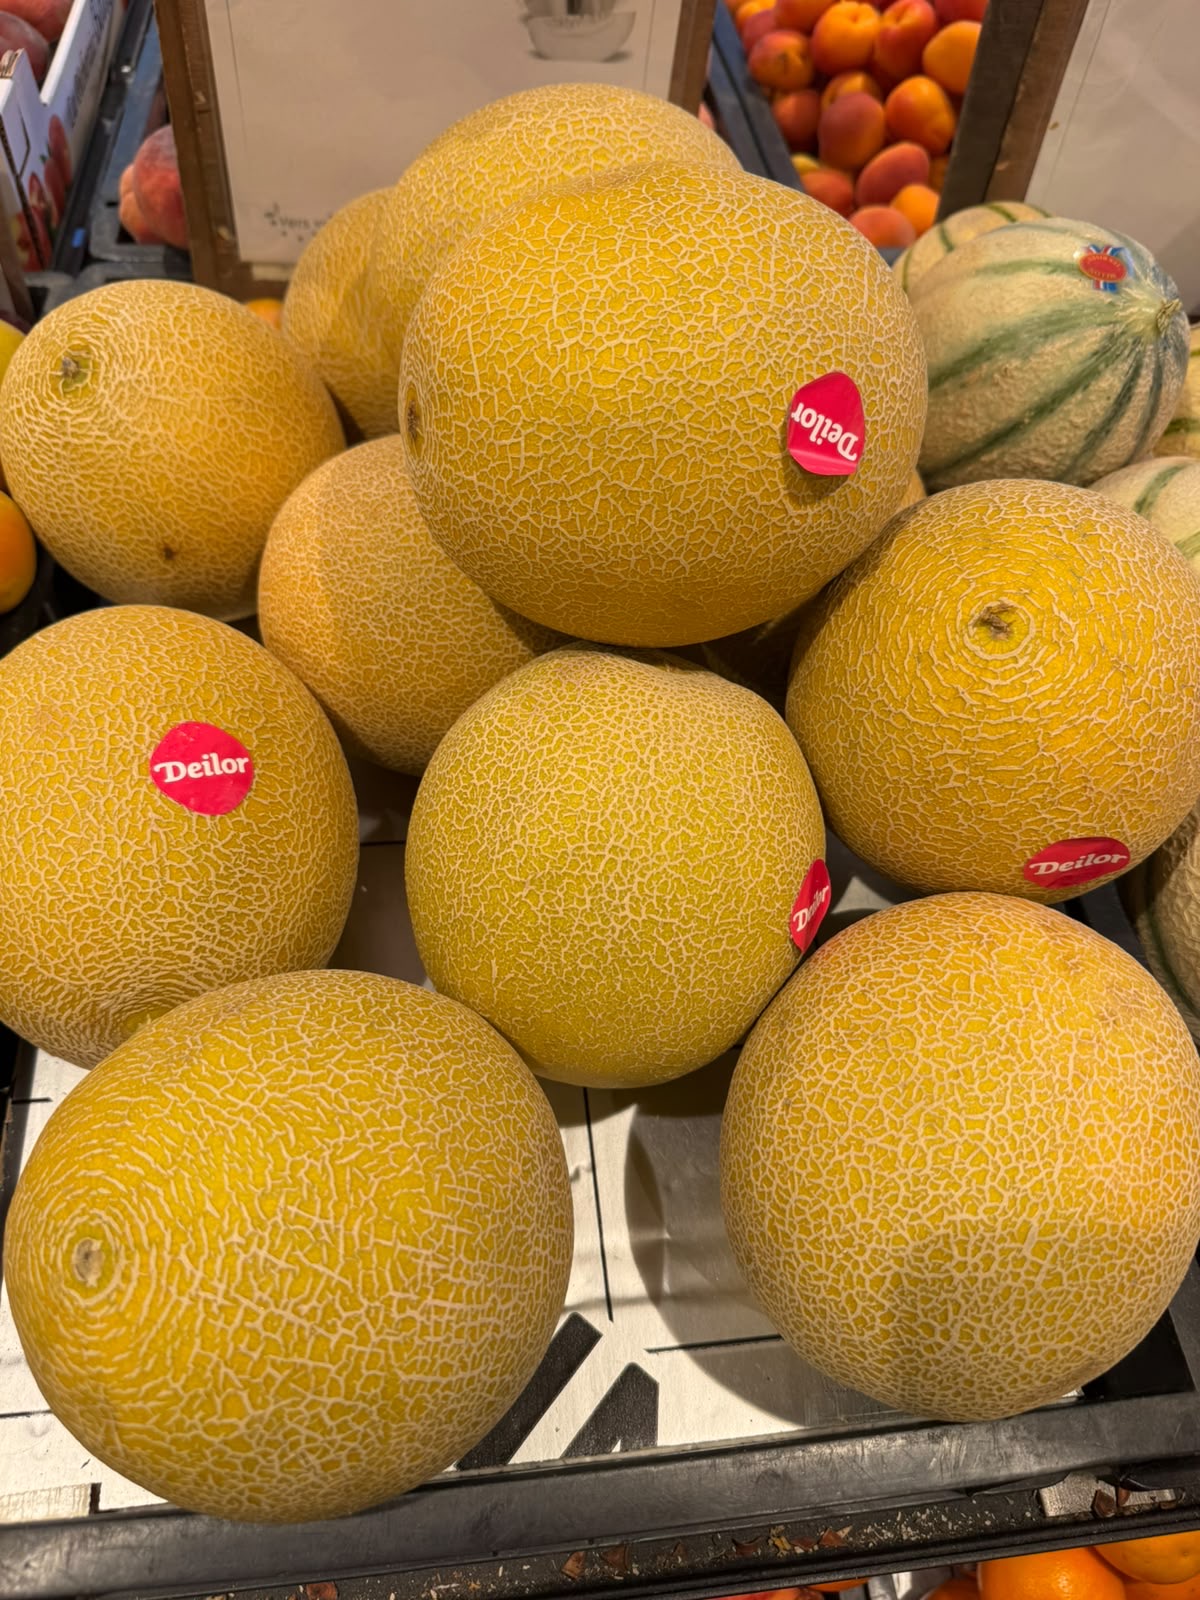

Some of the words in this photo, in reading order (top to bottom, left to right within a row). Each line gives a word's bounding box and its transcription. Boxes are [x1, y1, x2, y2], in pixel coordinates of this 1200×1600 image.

[791, 402, 859, 462] Deilor
[153, 752, 249, 783] Deilor
[1029, 853, 1128, 876] Deilor
[793, 885, 829, 932] Deilor
